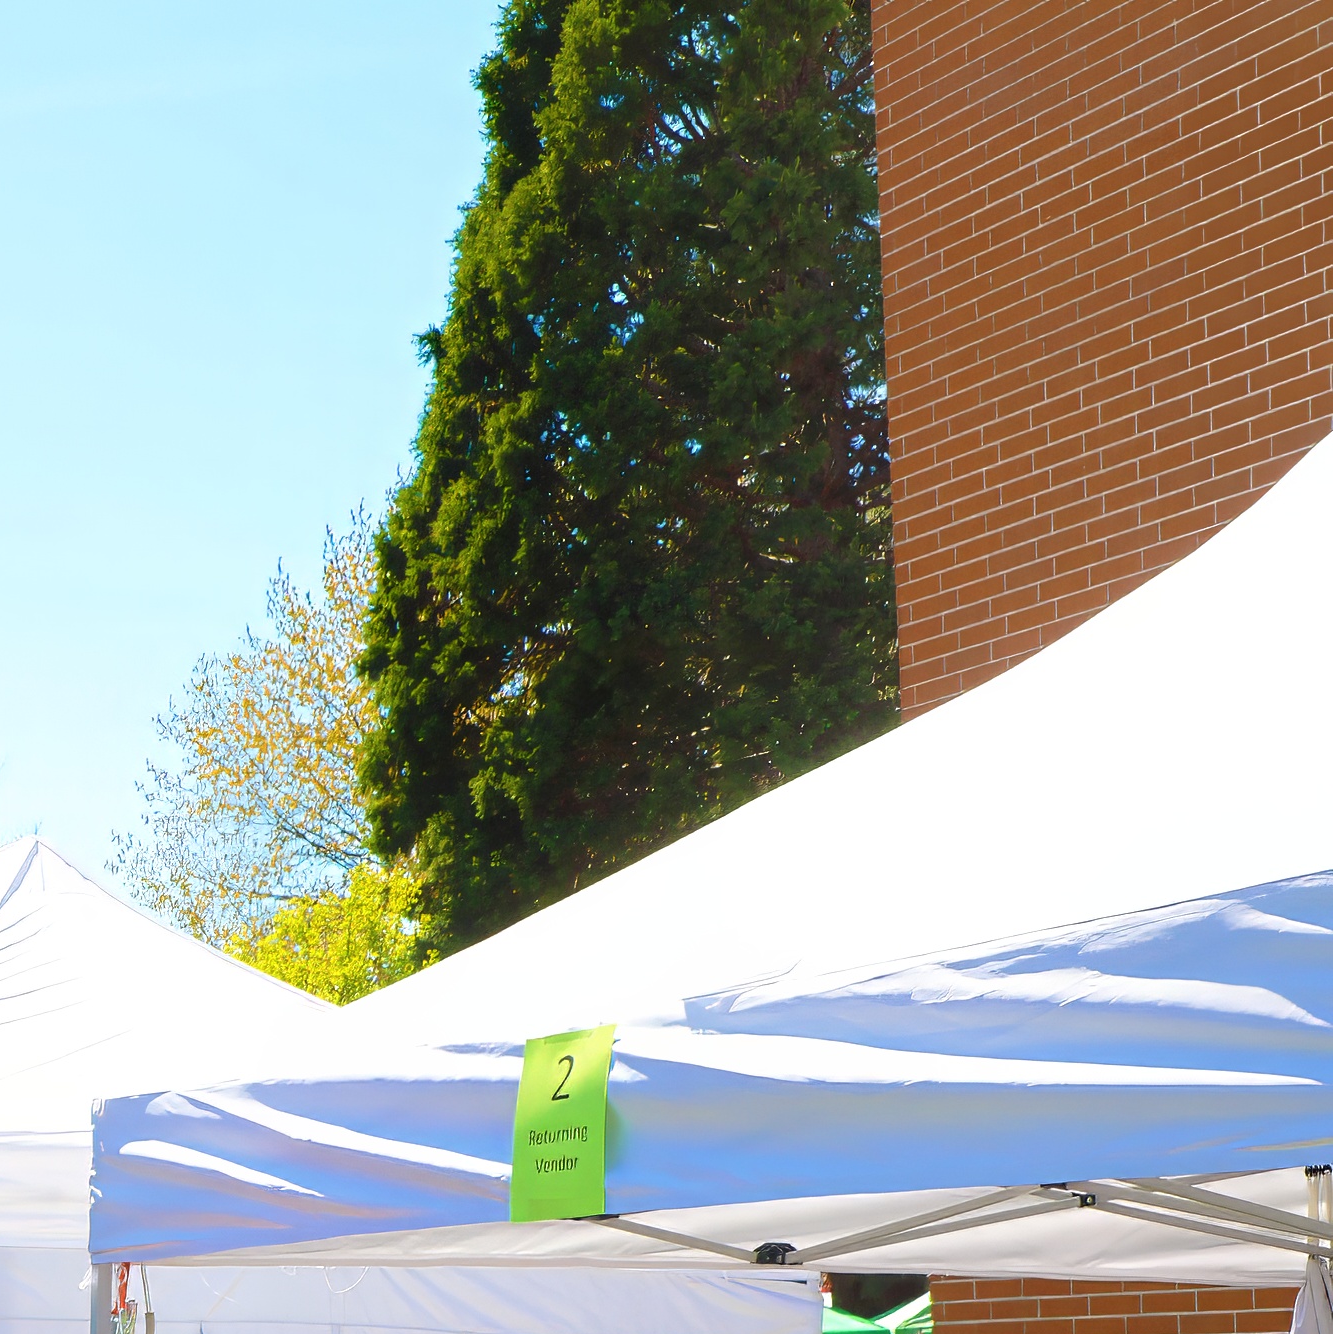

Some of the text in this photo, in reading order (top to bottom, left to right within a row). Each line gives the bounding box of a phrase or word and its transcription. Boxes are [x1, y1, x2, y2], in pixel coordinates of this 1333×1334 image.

[551, 1054, 575, 1101] 2
[528, 1126, 588, 1146] Returning
[535, 1155, 579, 1174] Vendor
